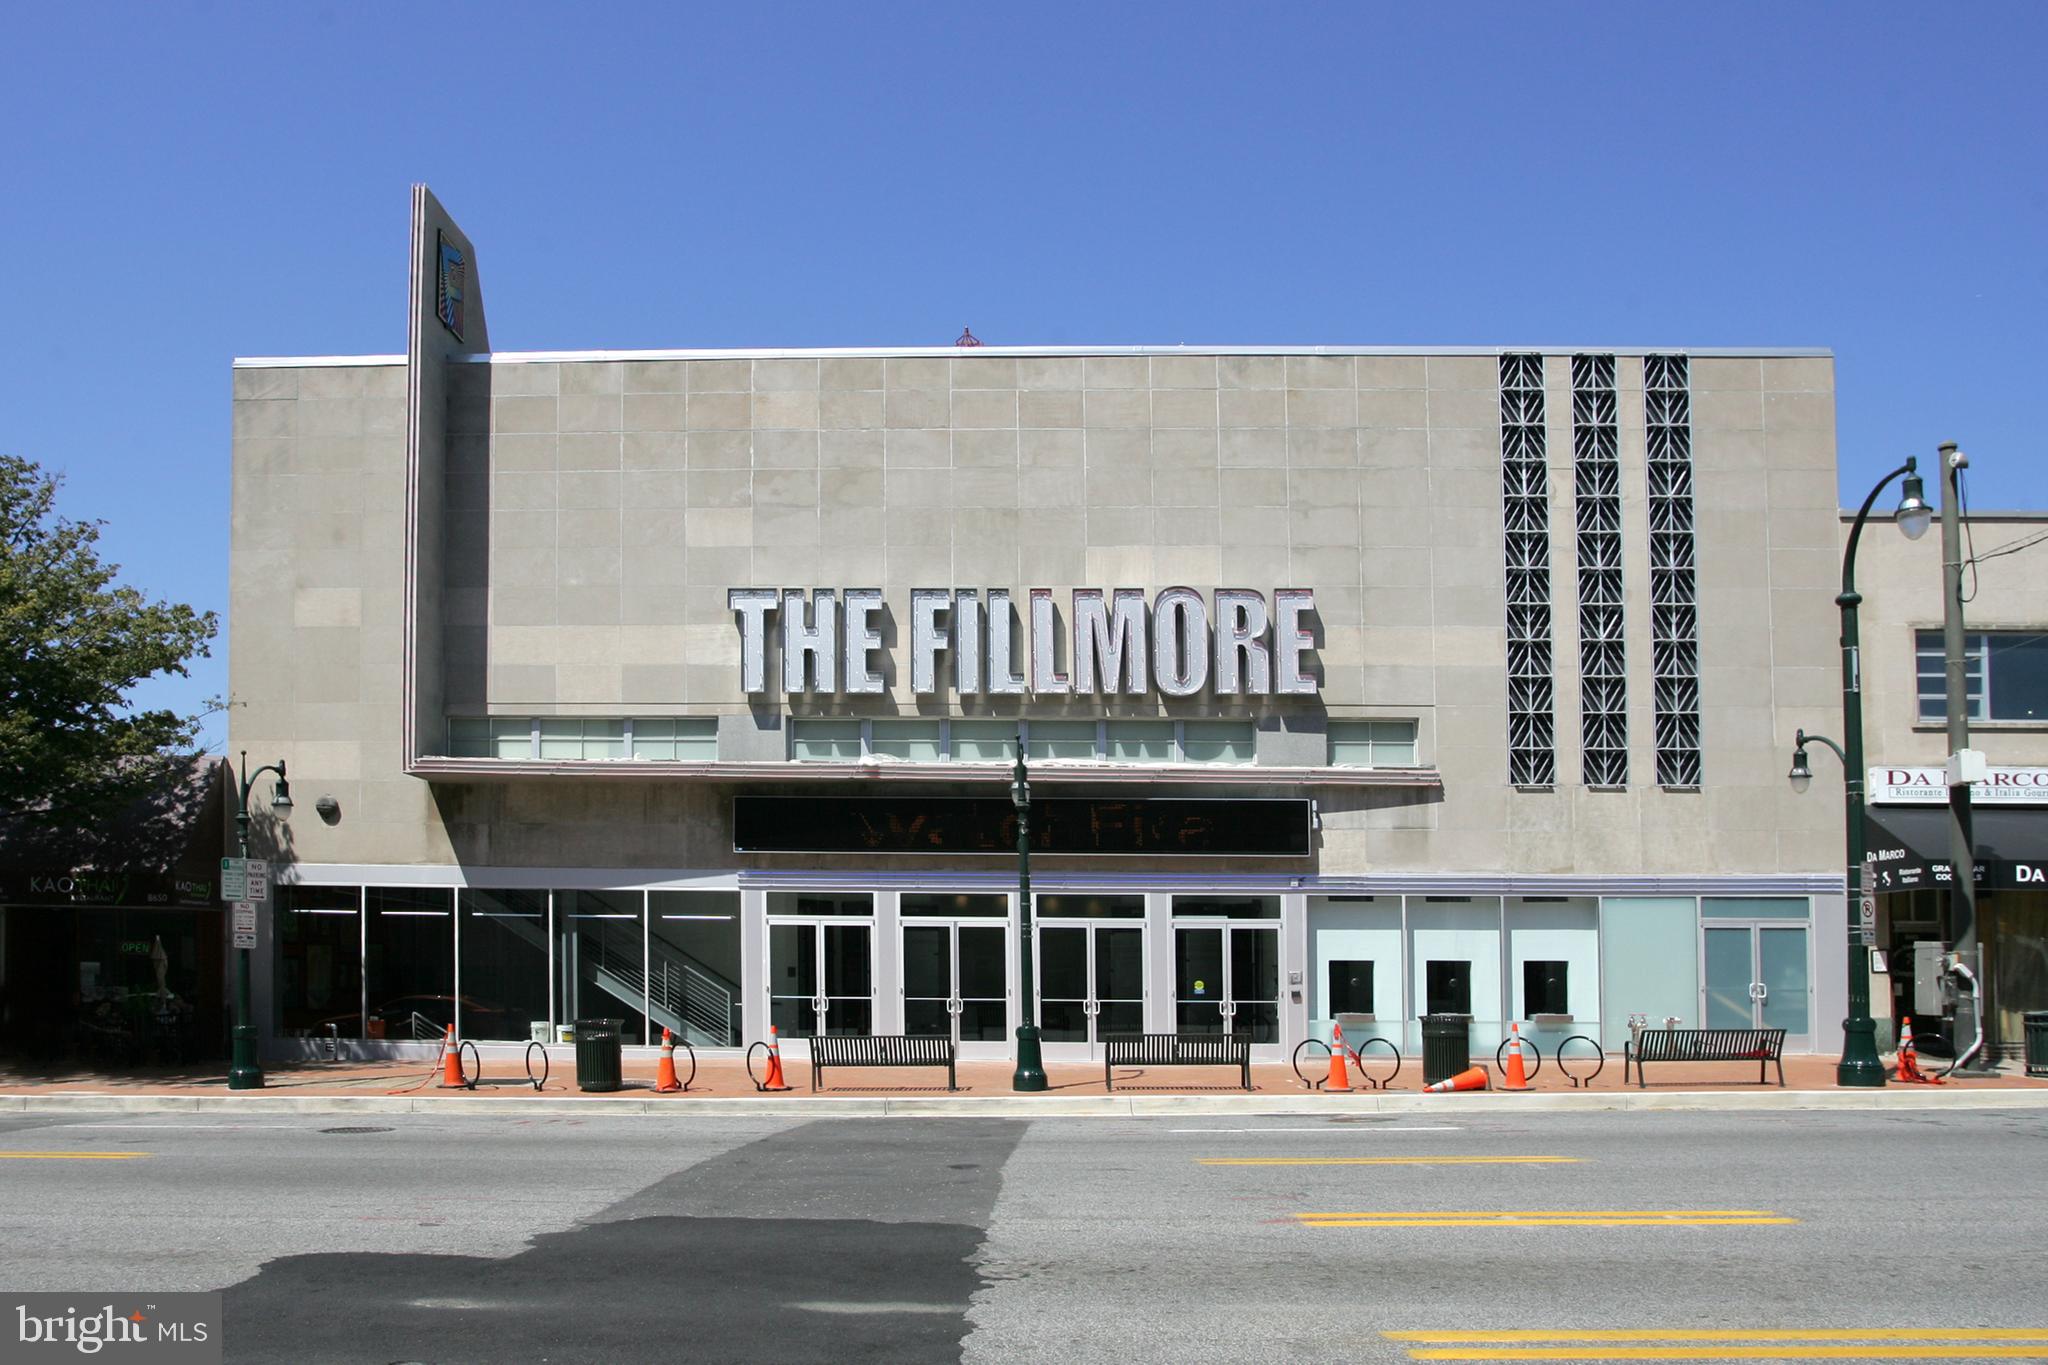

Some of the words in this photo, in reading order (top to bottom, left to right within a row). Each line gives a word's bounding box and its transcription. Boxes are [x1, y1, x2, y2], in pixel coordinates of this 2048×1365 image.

[728, 588, 885, 694] THE
[910, 586, 1318, 697] FILLMORE
[1887, 770, 1931, 786] DA
[1896, 787, 1943, 797] Ristorante
[1995, 788, 2021, 797] Italia
[1879, 849, 1906, 861] MARCO
[251, 863, 262, 871] NO
[2016, 865, 2046, 882] DA
[30, 877, 74, 893] KAO
[175, 880, 192, 893] KAO
[121, 943, 149, 953] OPEN
